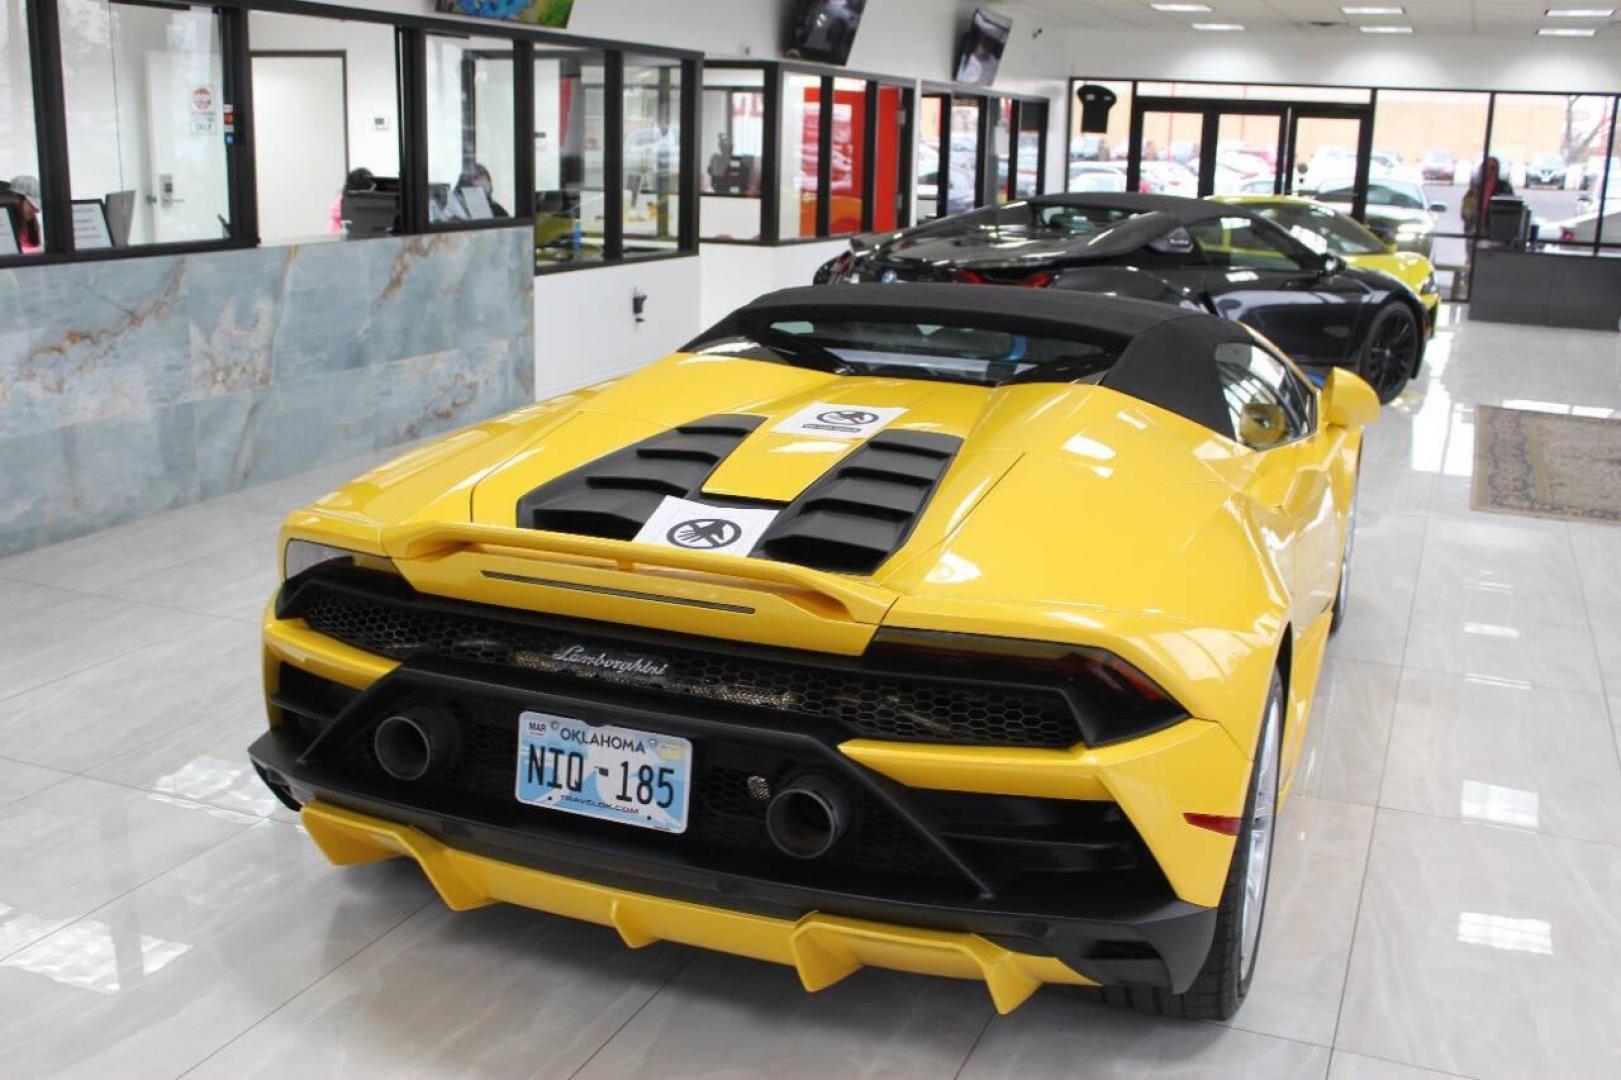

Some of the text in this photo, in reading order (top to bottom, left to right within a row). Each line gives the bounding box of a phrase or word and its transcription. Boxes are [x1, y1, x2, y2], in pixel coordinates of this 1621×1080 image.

[552, 644, 668, 675] Lamborghini
[528, 721, 547, 733] MAR
[560, 727, 647, 754] OKLAHOMA
